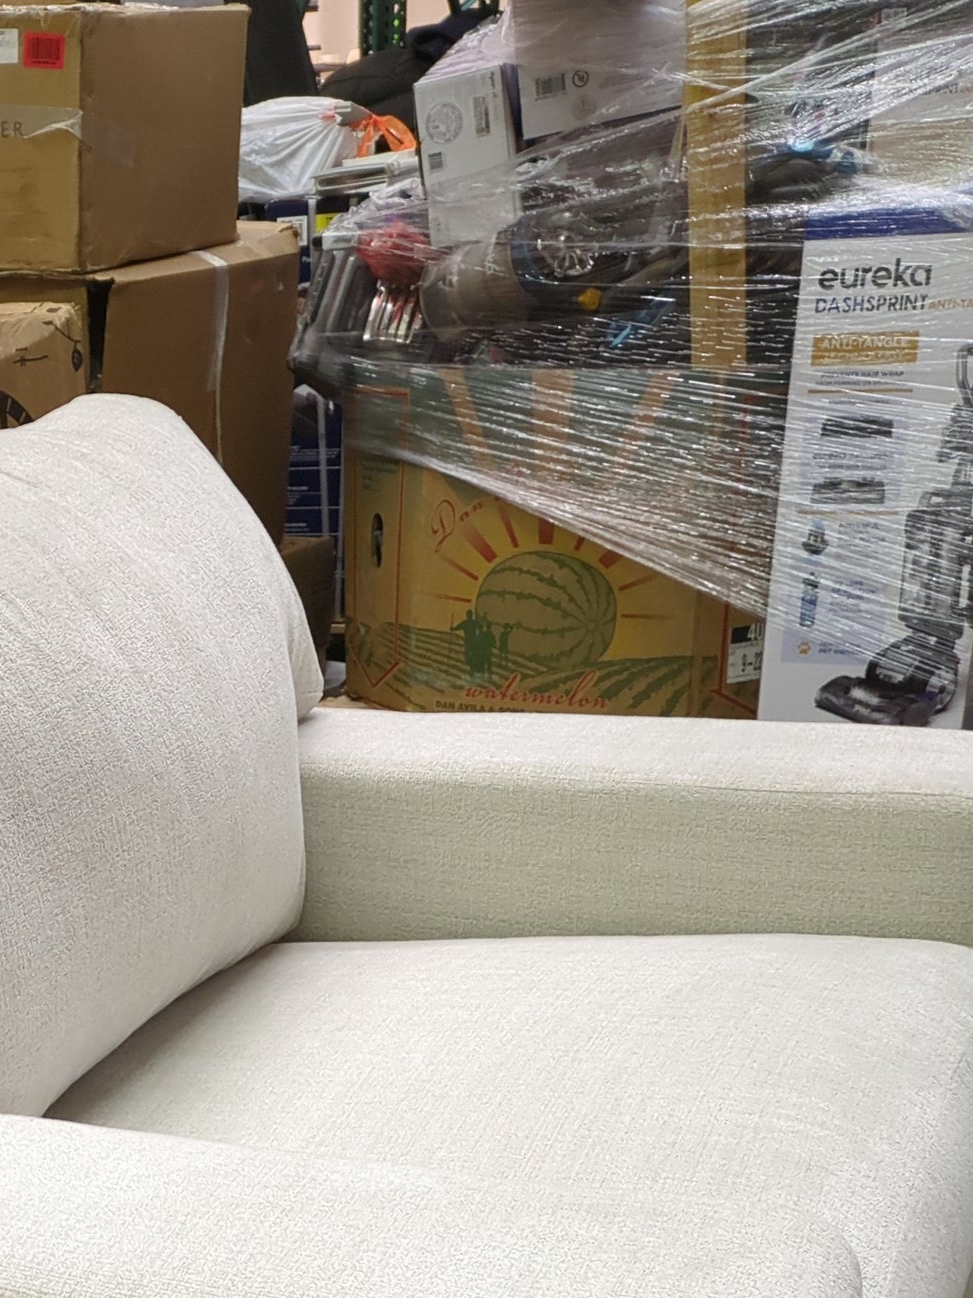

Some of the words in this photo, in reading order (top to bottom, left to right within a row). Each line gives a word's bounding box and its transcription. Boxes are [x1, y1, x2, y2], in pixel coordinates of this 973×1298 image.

[817, 257, 933, 290] eureka
[814, 294, 929, 314] DASHSPRINT
[465, 671, 610, 709] watermelon
[434, 700, 456, 710] DAN
